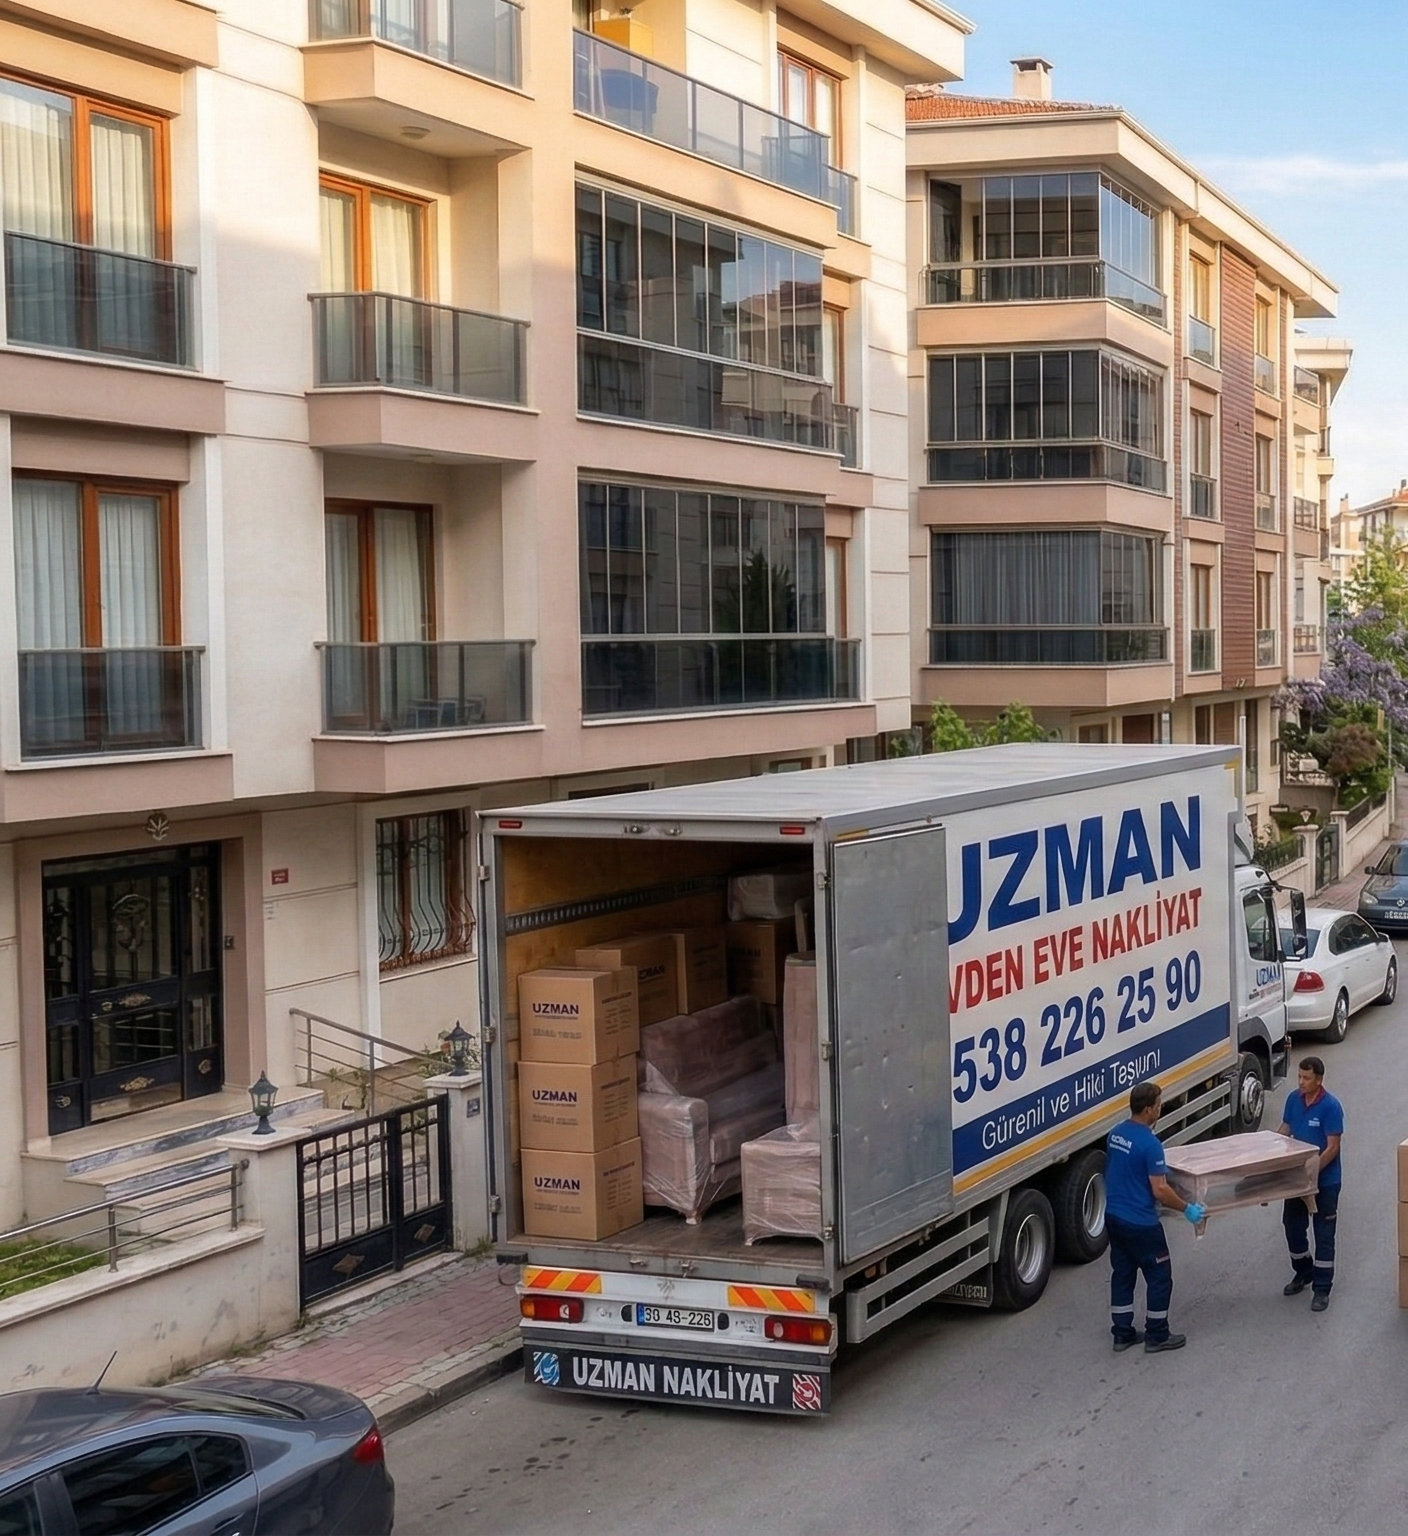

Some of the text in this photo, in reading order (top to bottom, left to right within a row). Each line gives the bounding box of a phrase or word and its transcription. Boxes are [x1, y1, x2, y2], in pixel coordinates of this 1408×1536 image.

[1034, 925, 1084, 984] EVE
[1092, 887, 1202, 964] NAKLİYAT
[532, 1002, 579, 1015] UZMAN
[953, 950, 1201, 1103] 538 226 25 90
[532, 1089, 577, 1103] UZMAN
[982, 1096, 1045, 1150] Gürenil
[1050, 1092, 1070, 1118] ve
[534, 1176, 580, 1190] UZMAN
[573, 1356, 780, 1404] UZMAN NAKLİYAT
